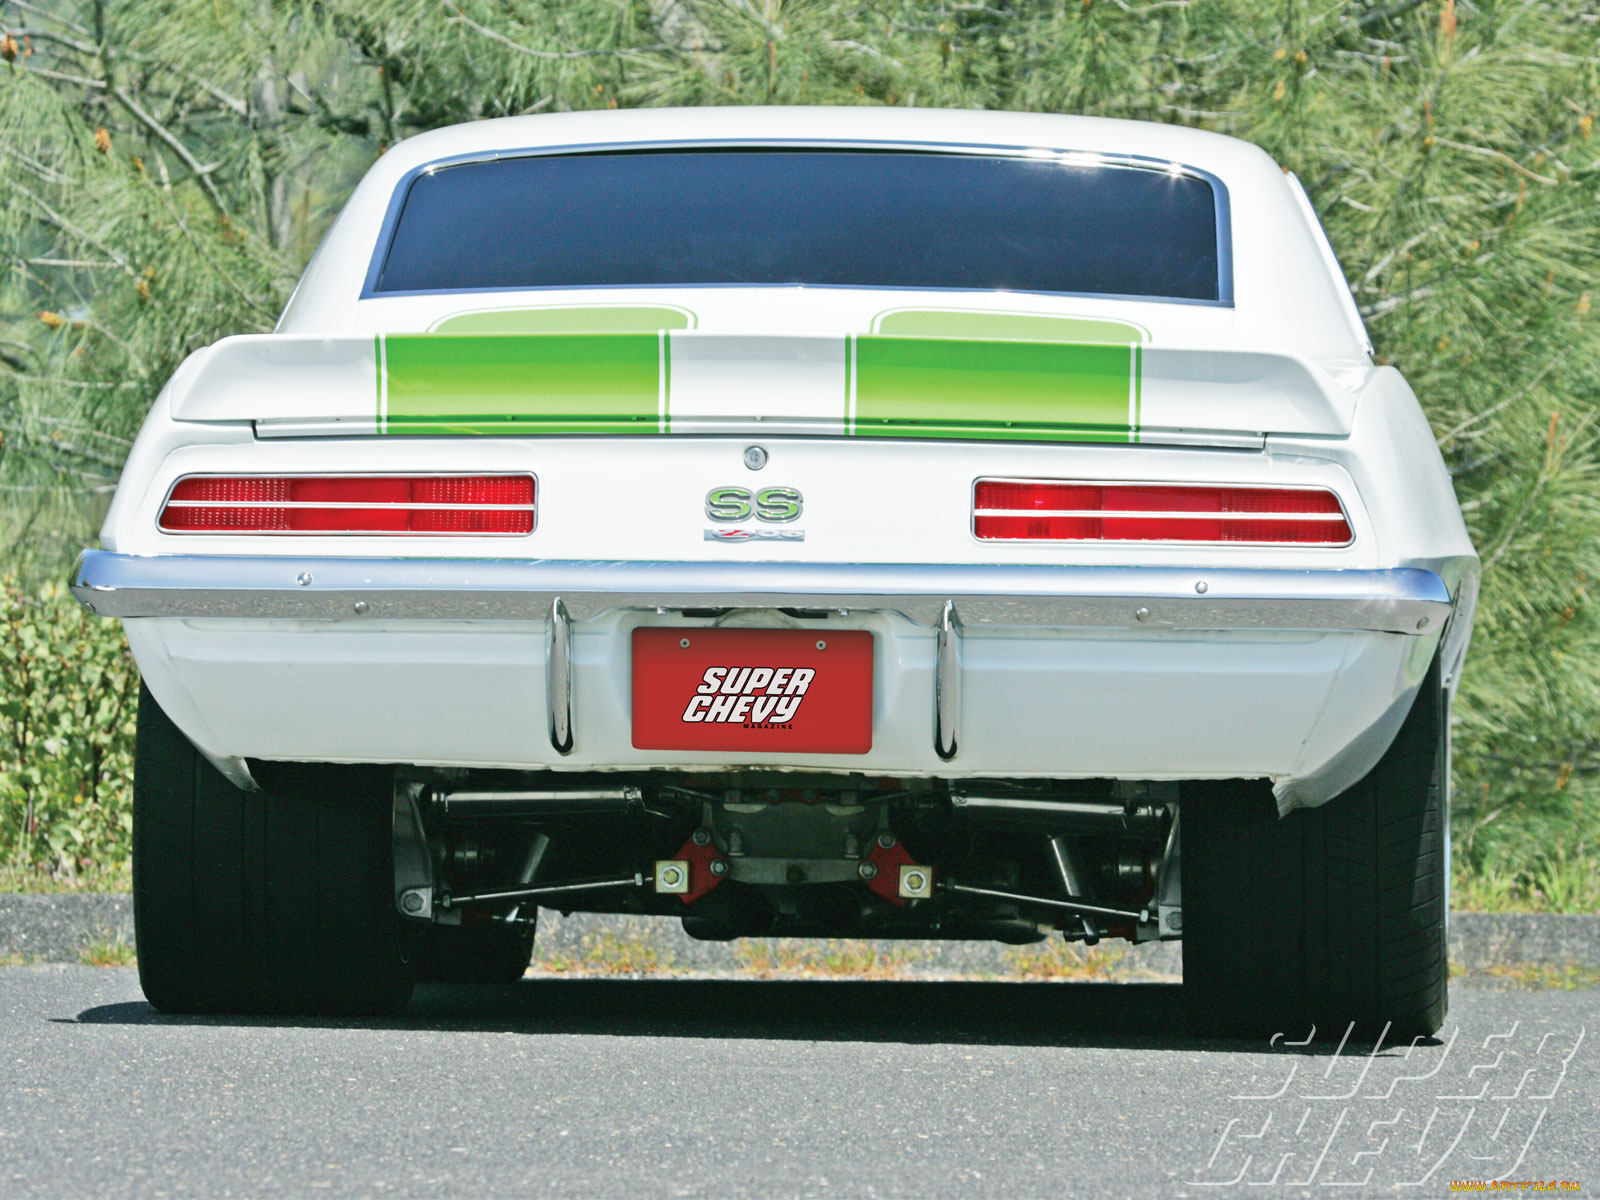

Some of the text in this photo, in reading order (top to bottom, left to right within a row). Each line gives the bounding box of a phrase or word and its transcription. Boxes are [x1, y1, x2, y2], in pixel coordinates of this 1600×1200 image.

[705, 486, 803, 523] SS
[696, 666, 816, 695] SUPER
[681, 695, 804, 723] CHEVY
